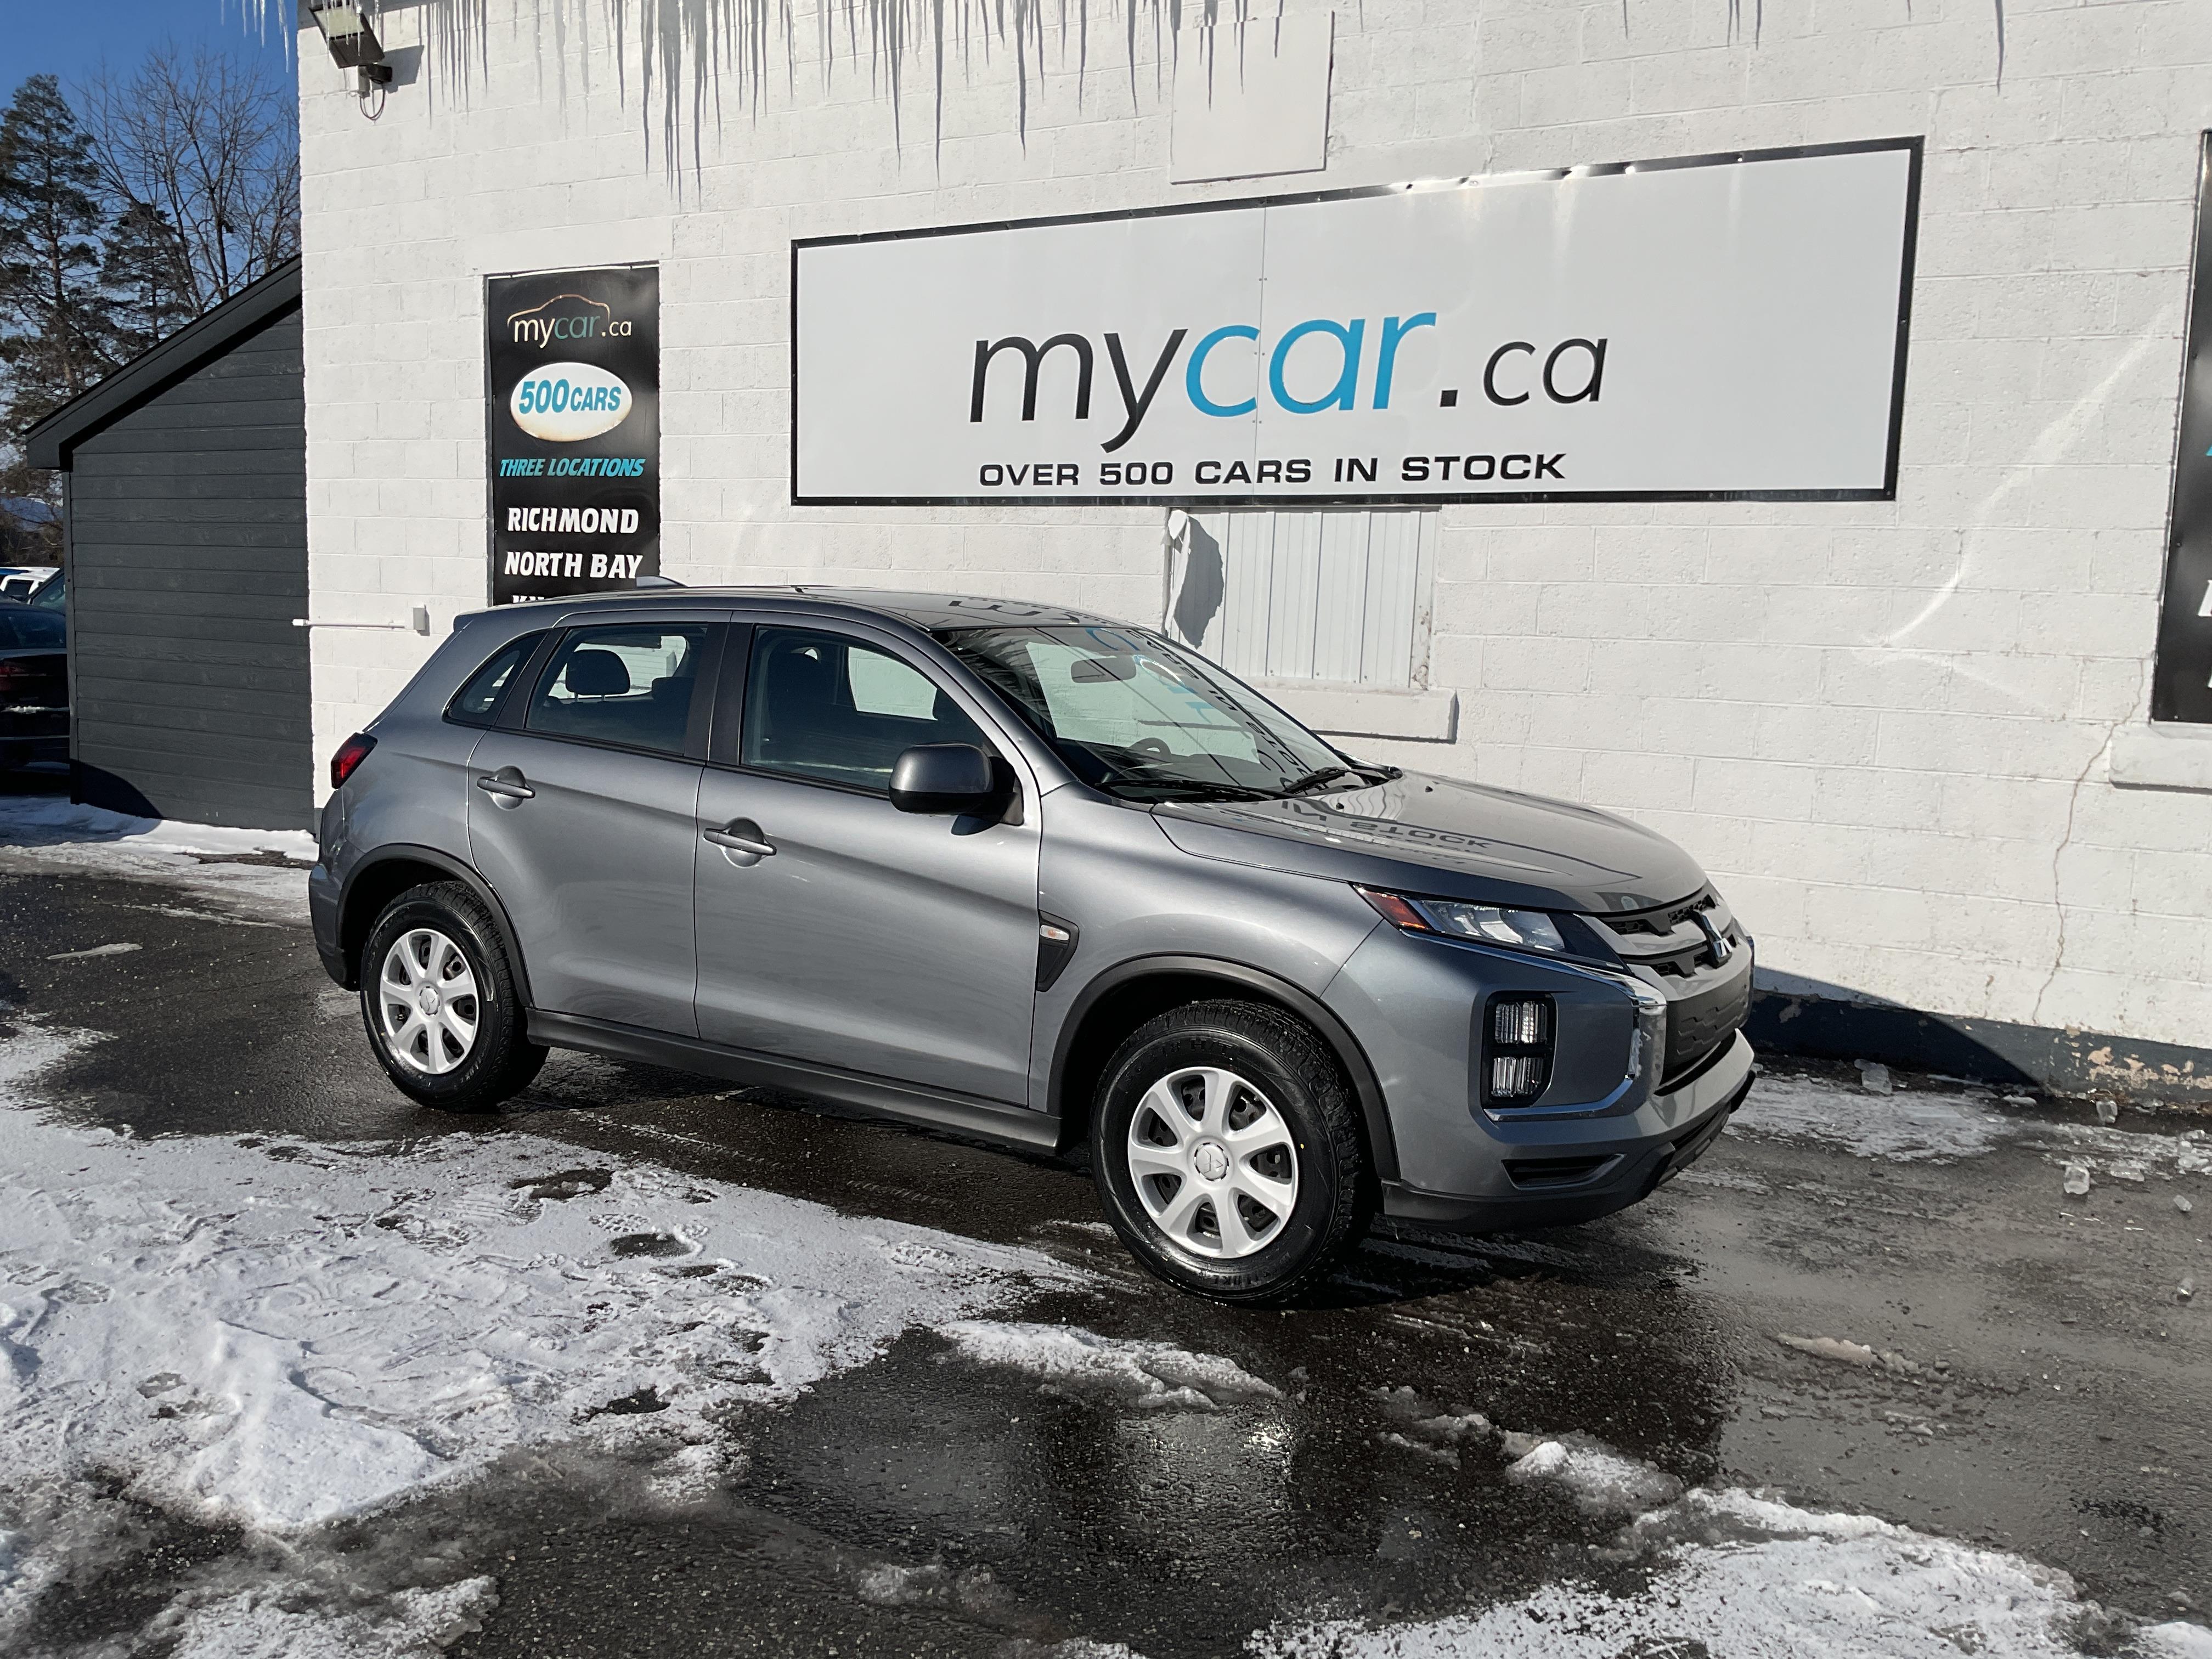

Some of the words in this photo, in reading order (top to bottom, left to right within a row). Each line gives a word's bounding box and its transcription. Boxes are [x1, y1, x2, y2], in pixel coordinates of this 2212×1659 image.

[500, 458, 544, 477] THREE
[547, 458, 645, 477] LOCATIONS
[980, 464, 1079, 486] OVER
[1099, 462, 1173, 486] 500
[1195, 459, 1311, 484] CARS
[1334, 458, 1378, 482] IN
[1402, 454, 1566, 481] STOCK
[507, 507, 639, 534] RICHMOND
[504, 551, 583, 578] NORTH
[590, 554, 644, 579] BAY
